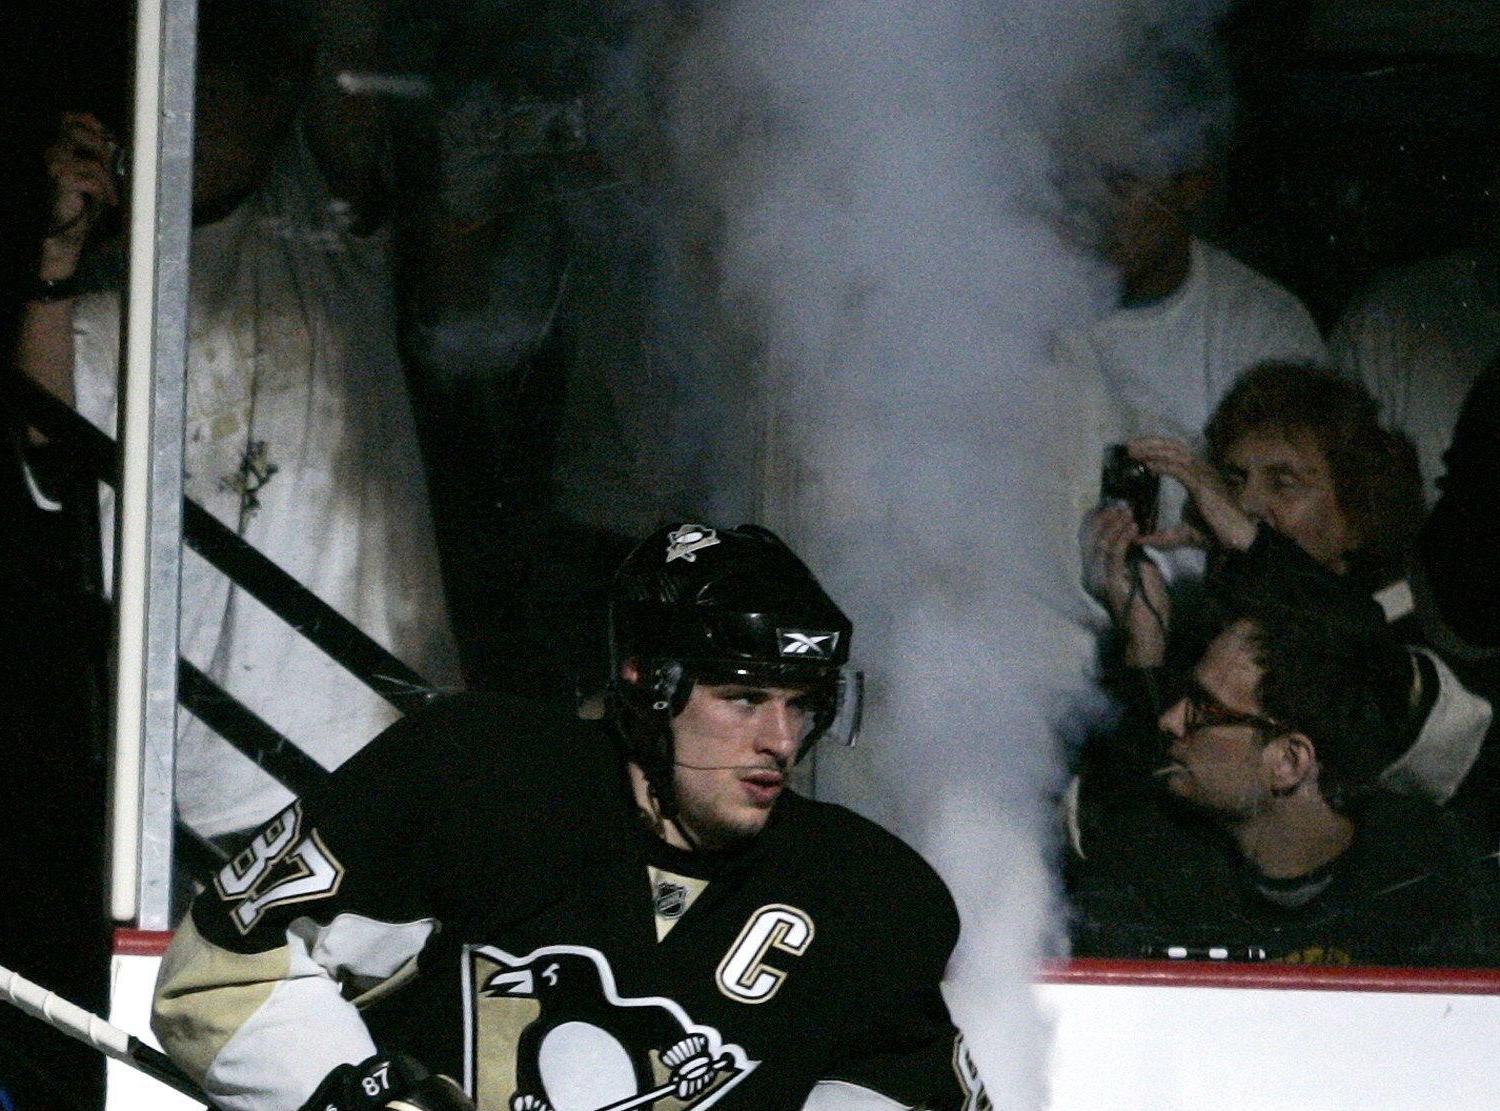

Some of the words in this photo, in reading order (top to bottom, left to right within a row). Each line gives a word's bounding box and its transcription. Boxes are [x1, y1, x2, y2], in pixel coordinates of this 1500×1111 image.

[212, 799, 345, 936] 87
[715, 903, 816, 1005] C
[361, 1060, 390, 1097] 87
